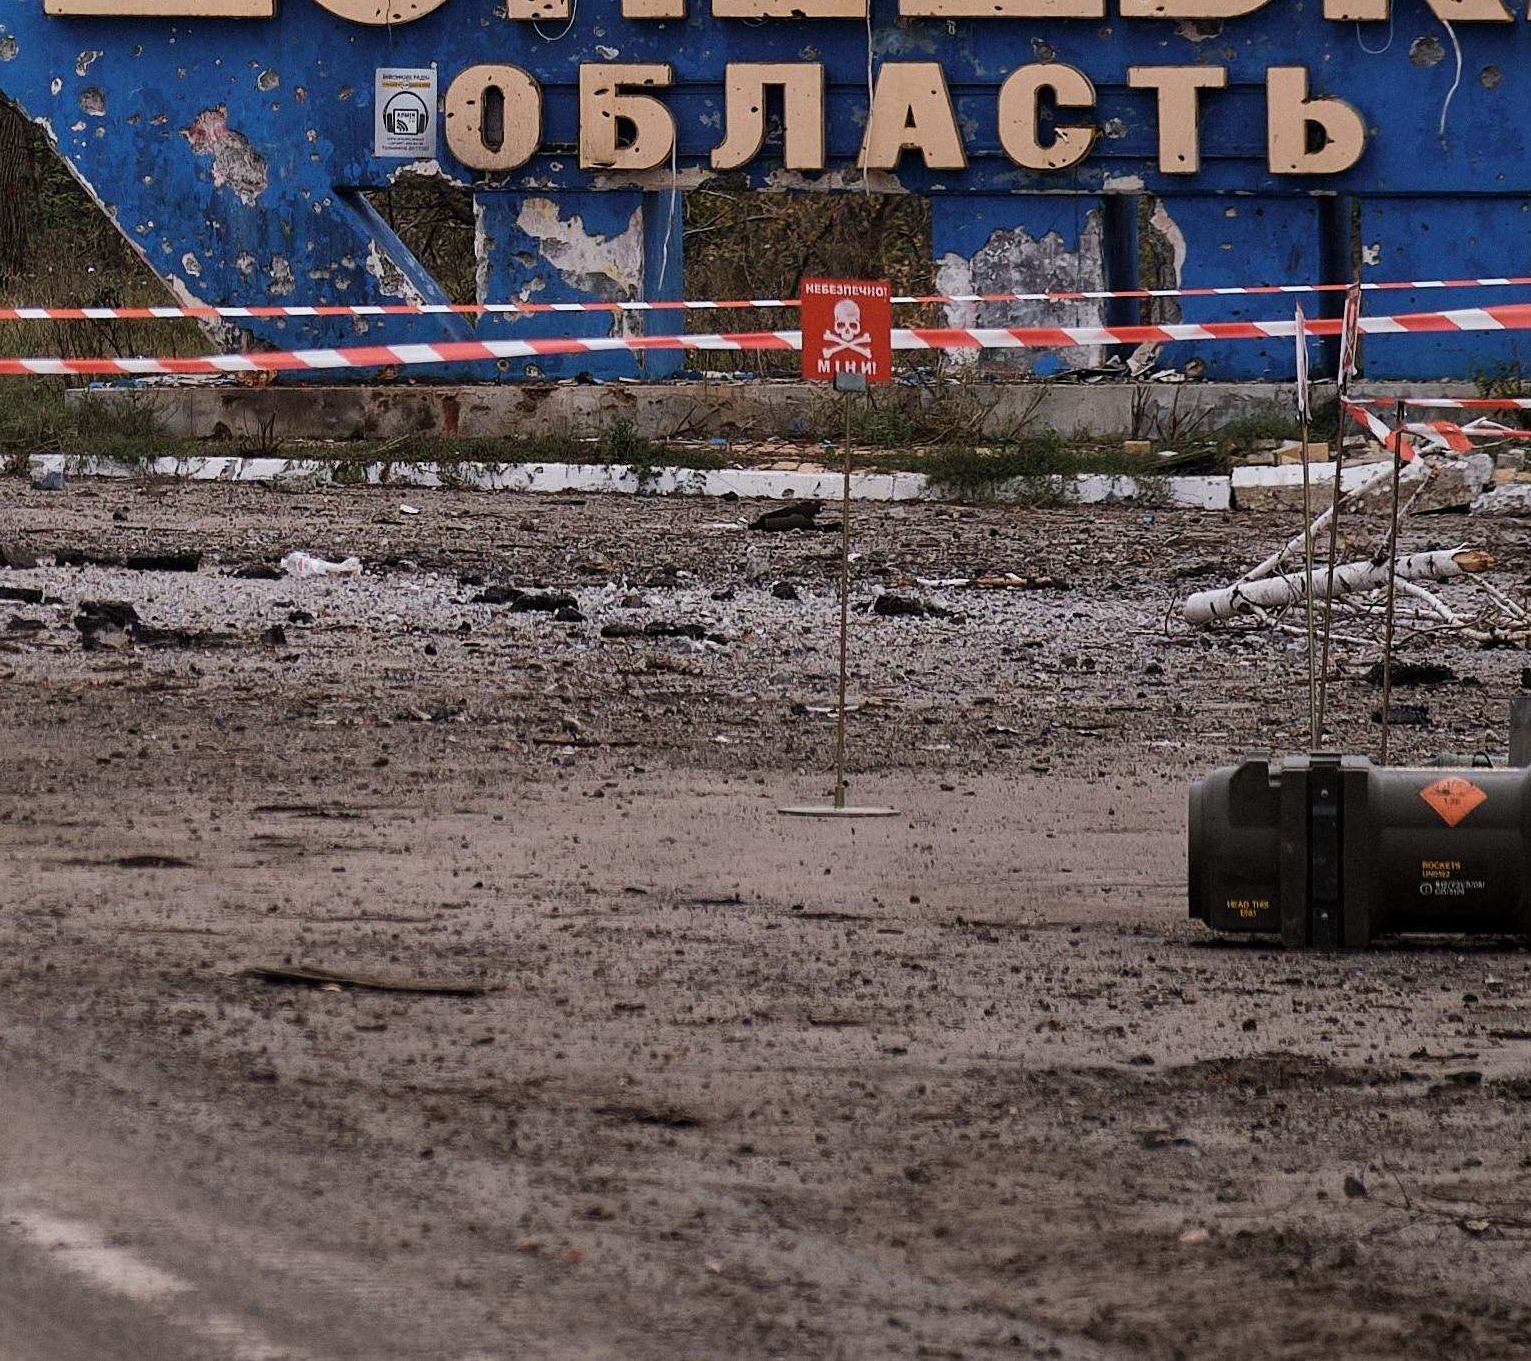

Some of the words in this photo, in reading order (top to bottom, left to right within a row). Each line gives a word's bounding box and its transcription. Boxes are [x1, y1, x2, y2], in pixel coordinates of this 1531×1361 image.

[443, 61, 1368, 176] ОБЛАСТЬ
[805, 283, 888, 297] НЕБЕЗПЕЧНО!
[817, 359, 877, 375] МІНИ!
